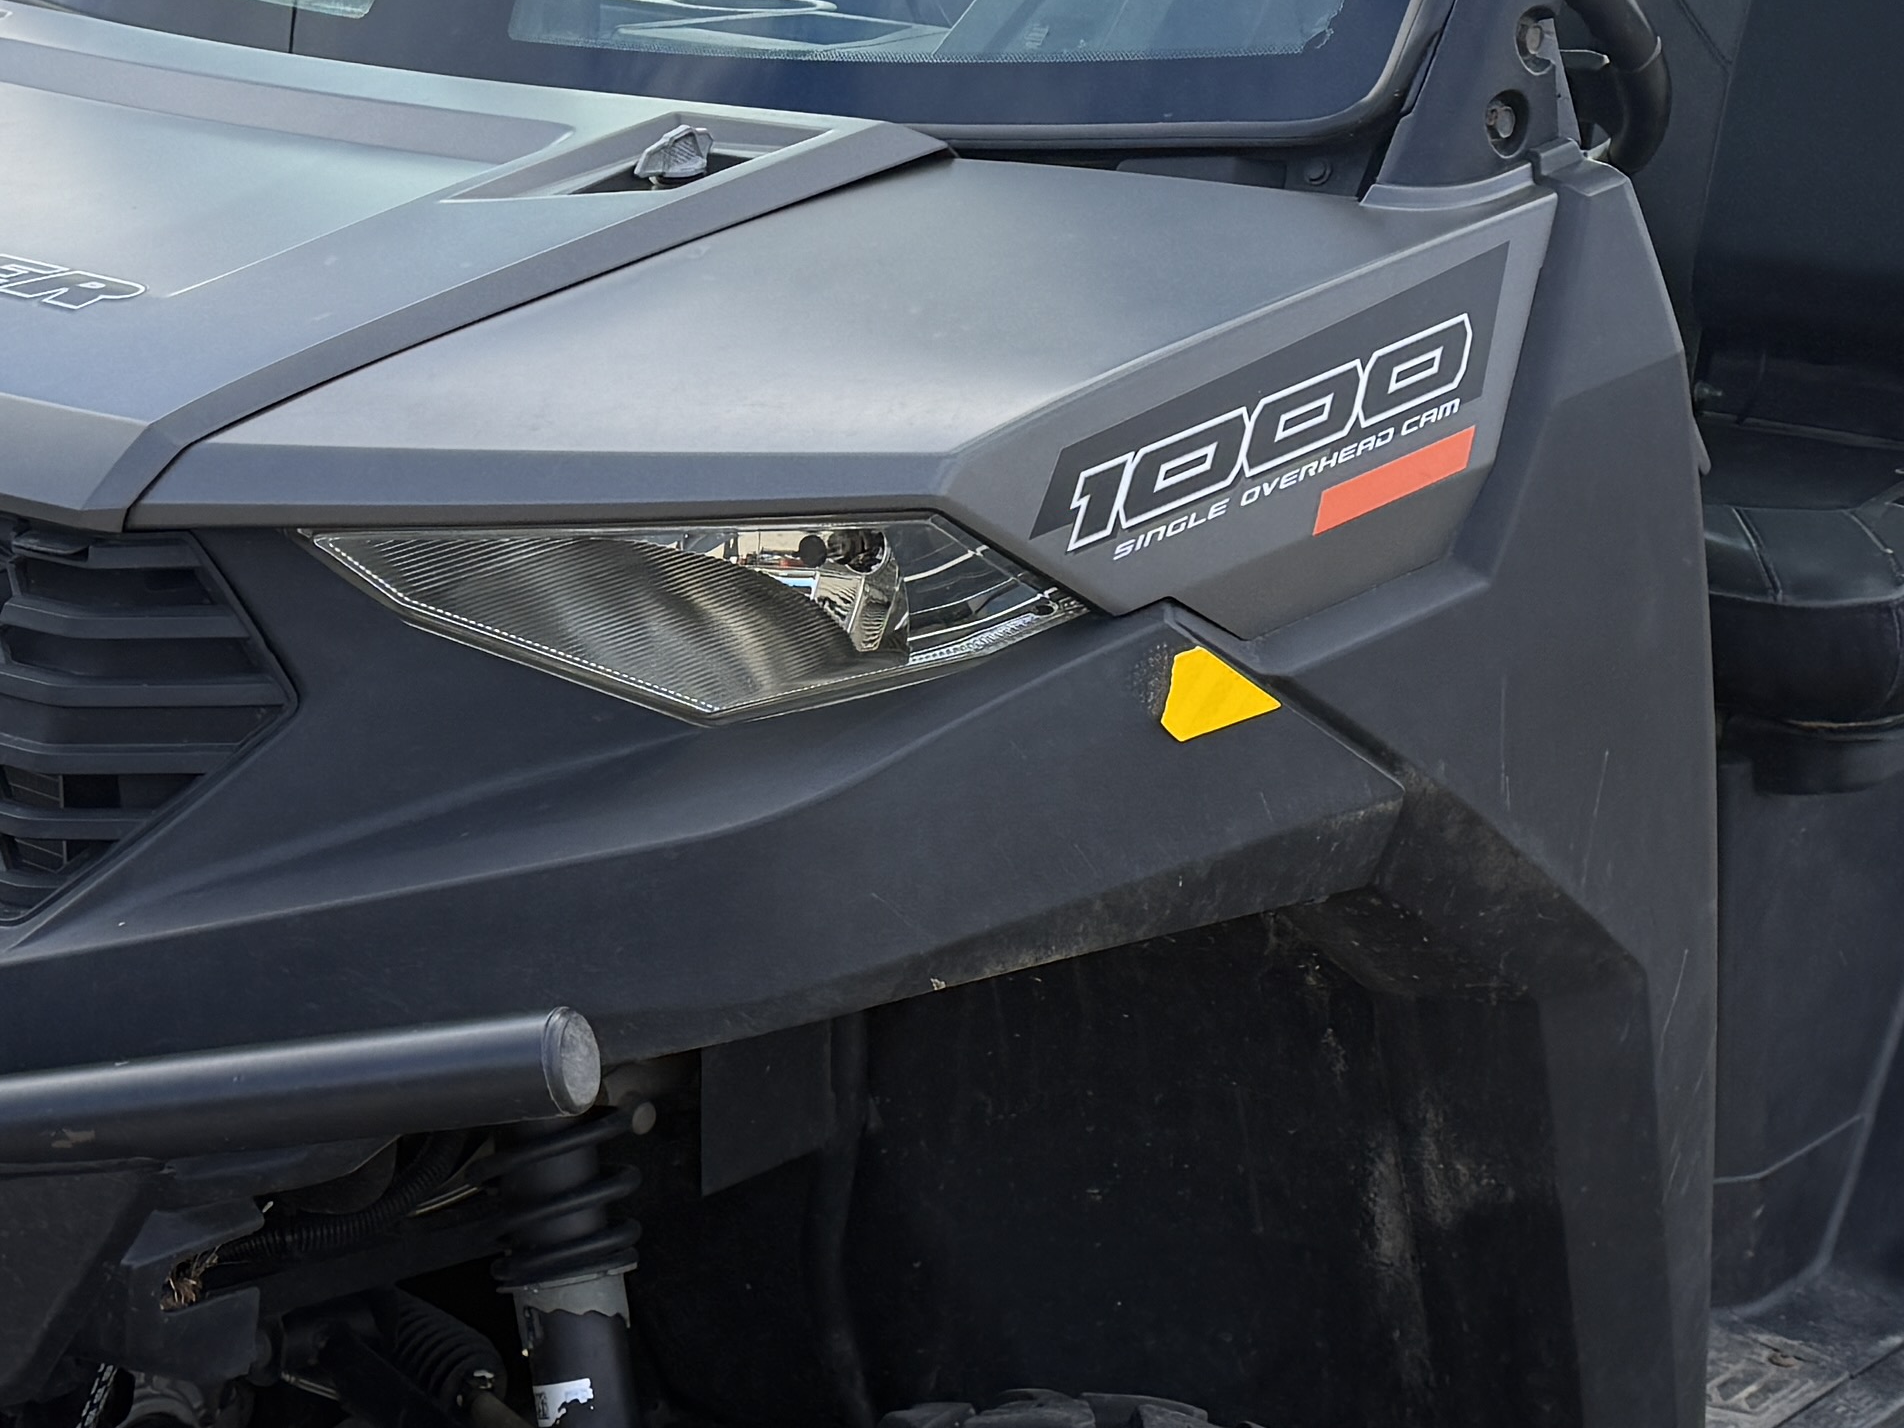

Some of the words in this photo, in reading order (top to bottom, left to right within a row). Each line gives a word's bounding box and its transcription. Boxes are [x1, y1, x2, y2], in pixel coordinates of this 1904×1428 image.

[1066, 313, 1472, 551] 1000
[1113, 499, 1228, 560] SINGLE
[1241, 429, 1394, 506] OVERHEAD
[1401, 398, 1461, 436] CAM
